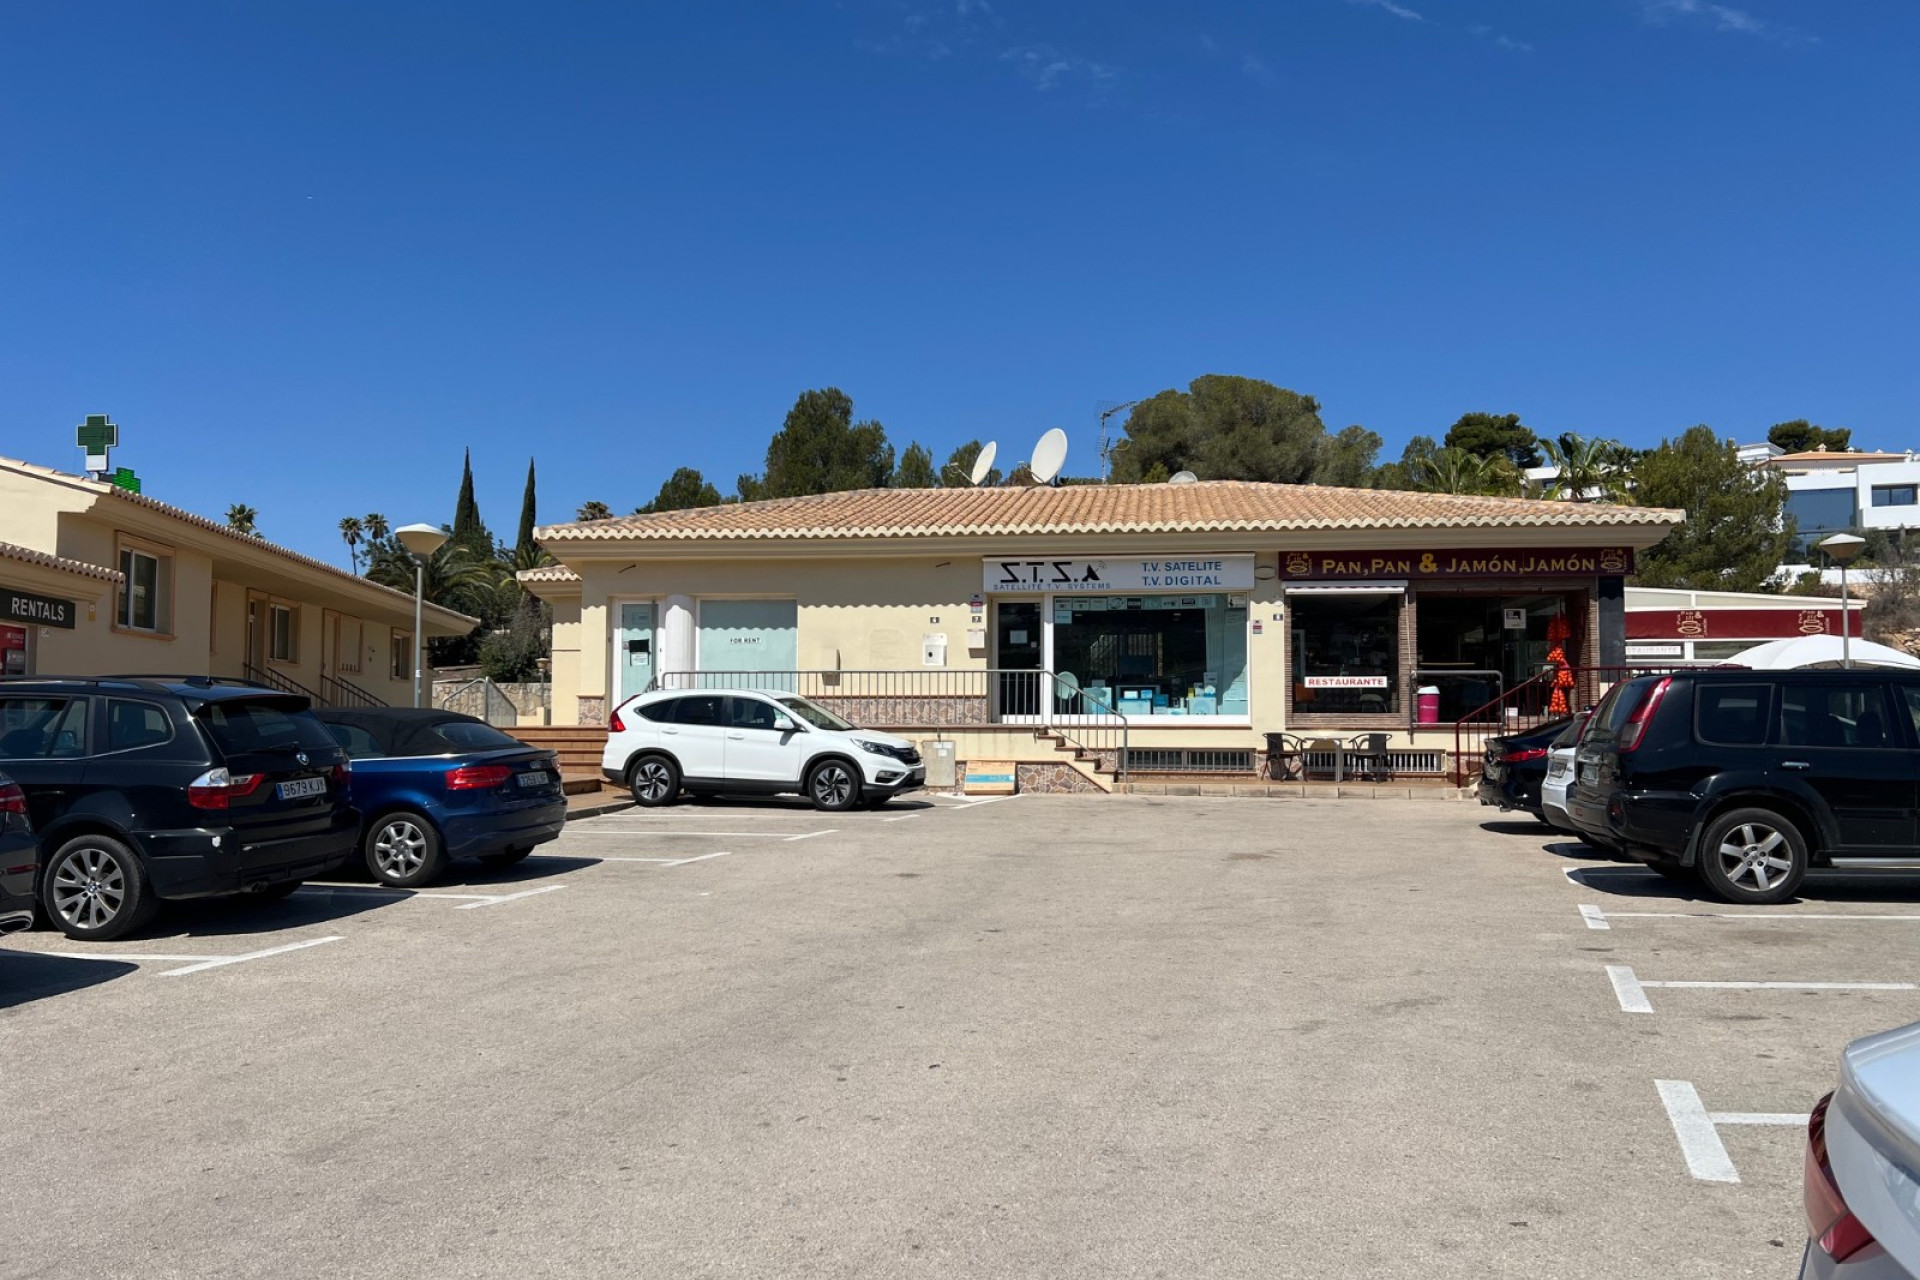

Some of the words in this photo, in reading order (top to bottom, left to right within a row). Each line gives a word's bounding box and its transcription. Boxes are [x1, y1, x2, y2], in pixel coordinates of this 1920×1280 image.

[1142, 562, 1161, 572] T.V.
[1164, 561, 1222, 571] SATELITE
[1419, 553, 1437, 573] &
[1142, 576, 1161, 586] T.V.
[1165, 575, 1222, 586] DIGITAL
[993, 583, 1041, 591] SATELLITE
[1067, 582, 1111, 590] SYSTEMS
[11, 596, 65, 621] RENTALS
[744, 637, 761, 645] RENT
[1308, 678, 1384, 686] RESTAURANTE
[283, 781, 307, 797] 9679
